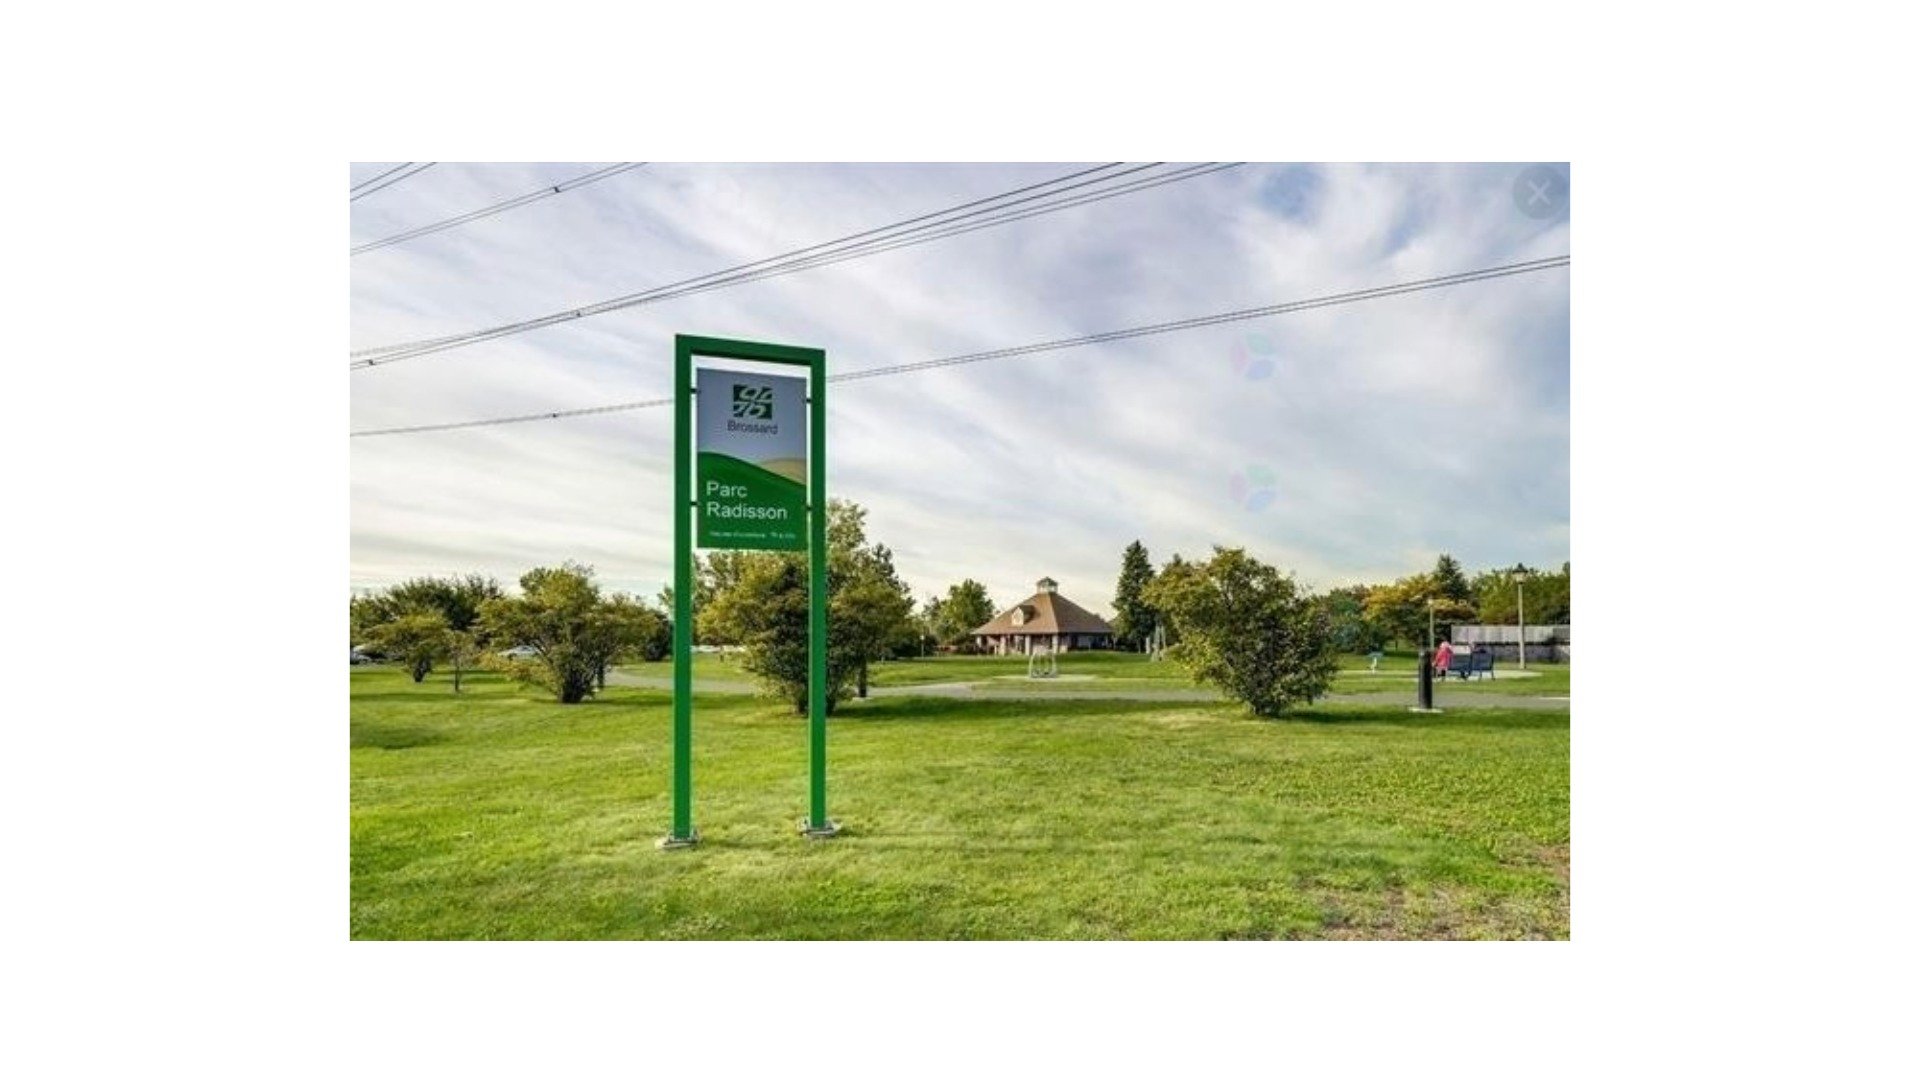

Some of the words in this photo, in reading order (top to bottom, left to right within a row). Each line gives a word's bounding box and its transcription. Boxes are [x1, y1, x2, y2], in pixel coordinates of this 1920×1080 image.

[727, 420, 778, 435] Brossard
[706, 481, 748, 498] Parc
[706, 501, 788, 519] Radisson
